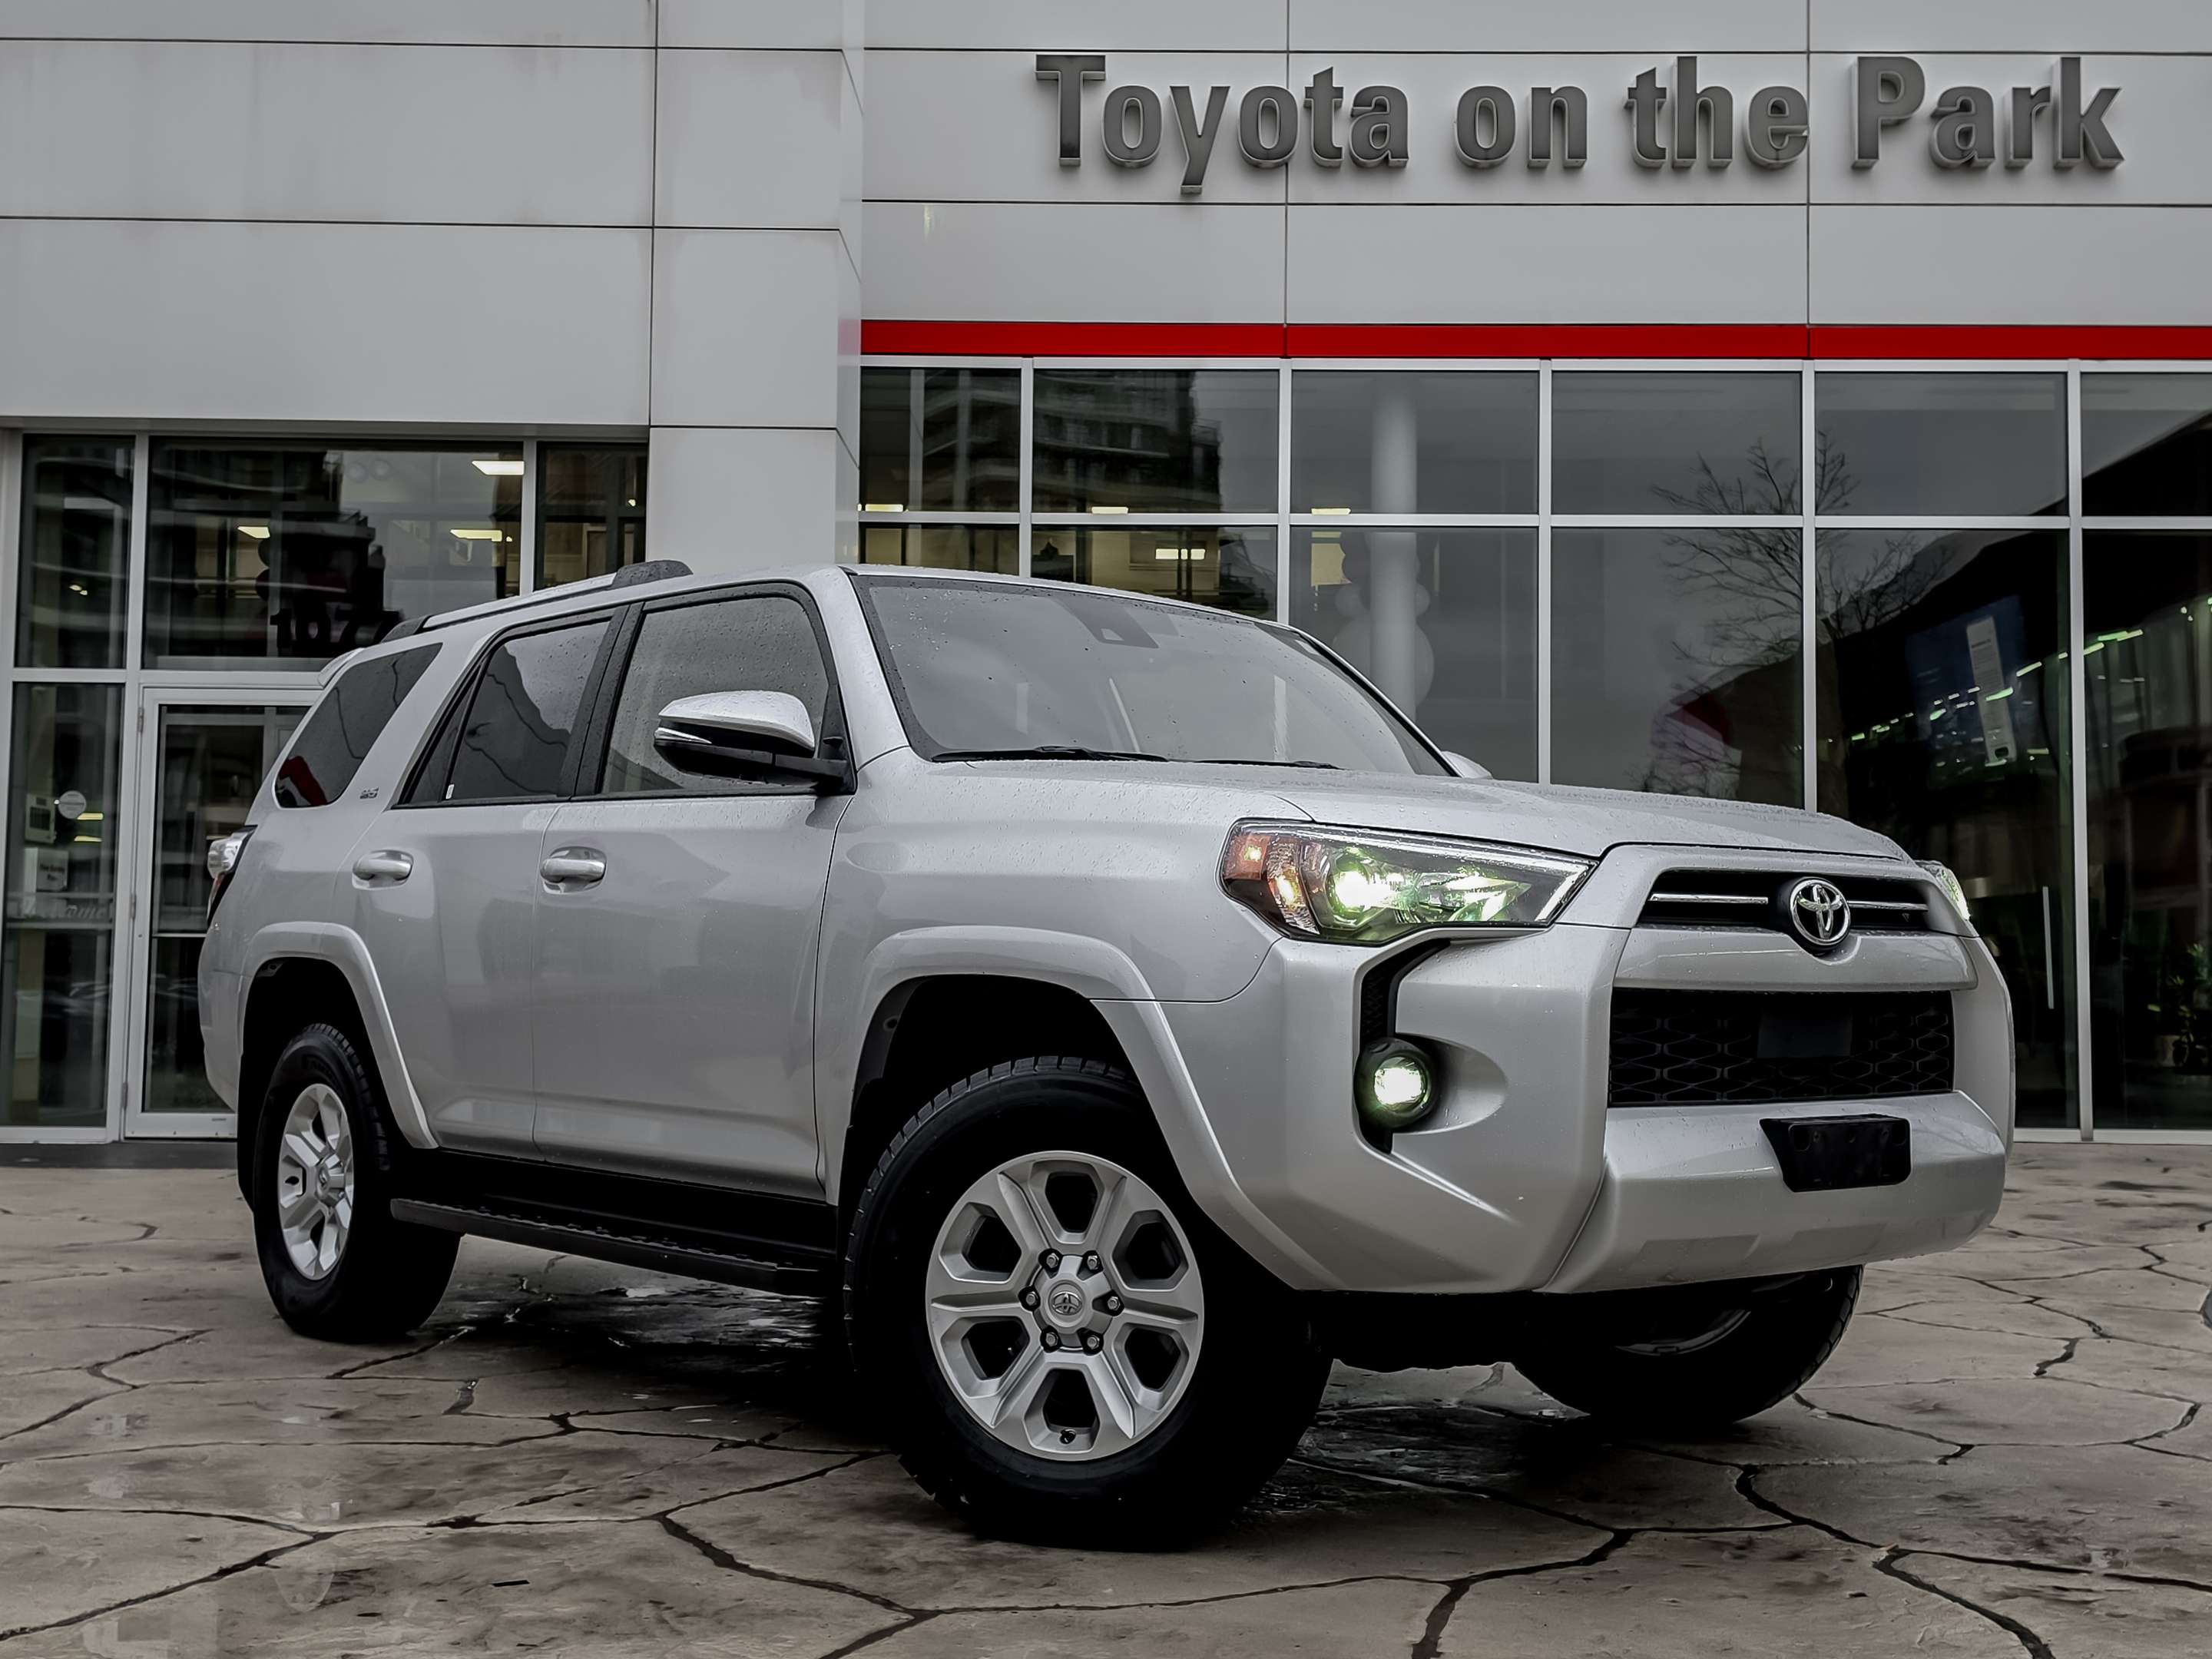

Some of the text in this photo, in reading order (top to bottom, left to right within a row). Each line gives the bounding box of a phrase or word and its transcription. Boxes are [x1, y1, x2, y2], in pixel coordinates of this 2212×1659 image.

[1035, 55, 2125, 193] Toyota on the Park
[270, 608, 404, 650] 1077
